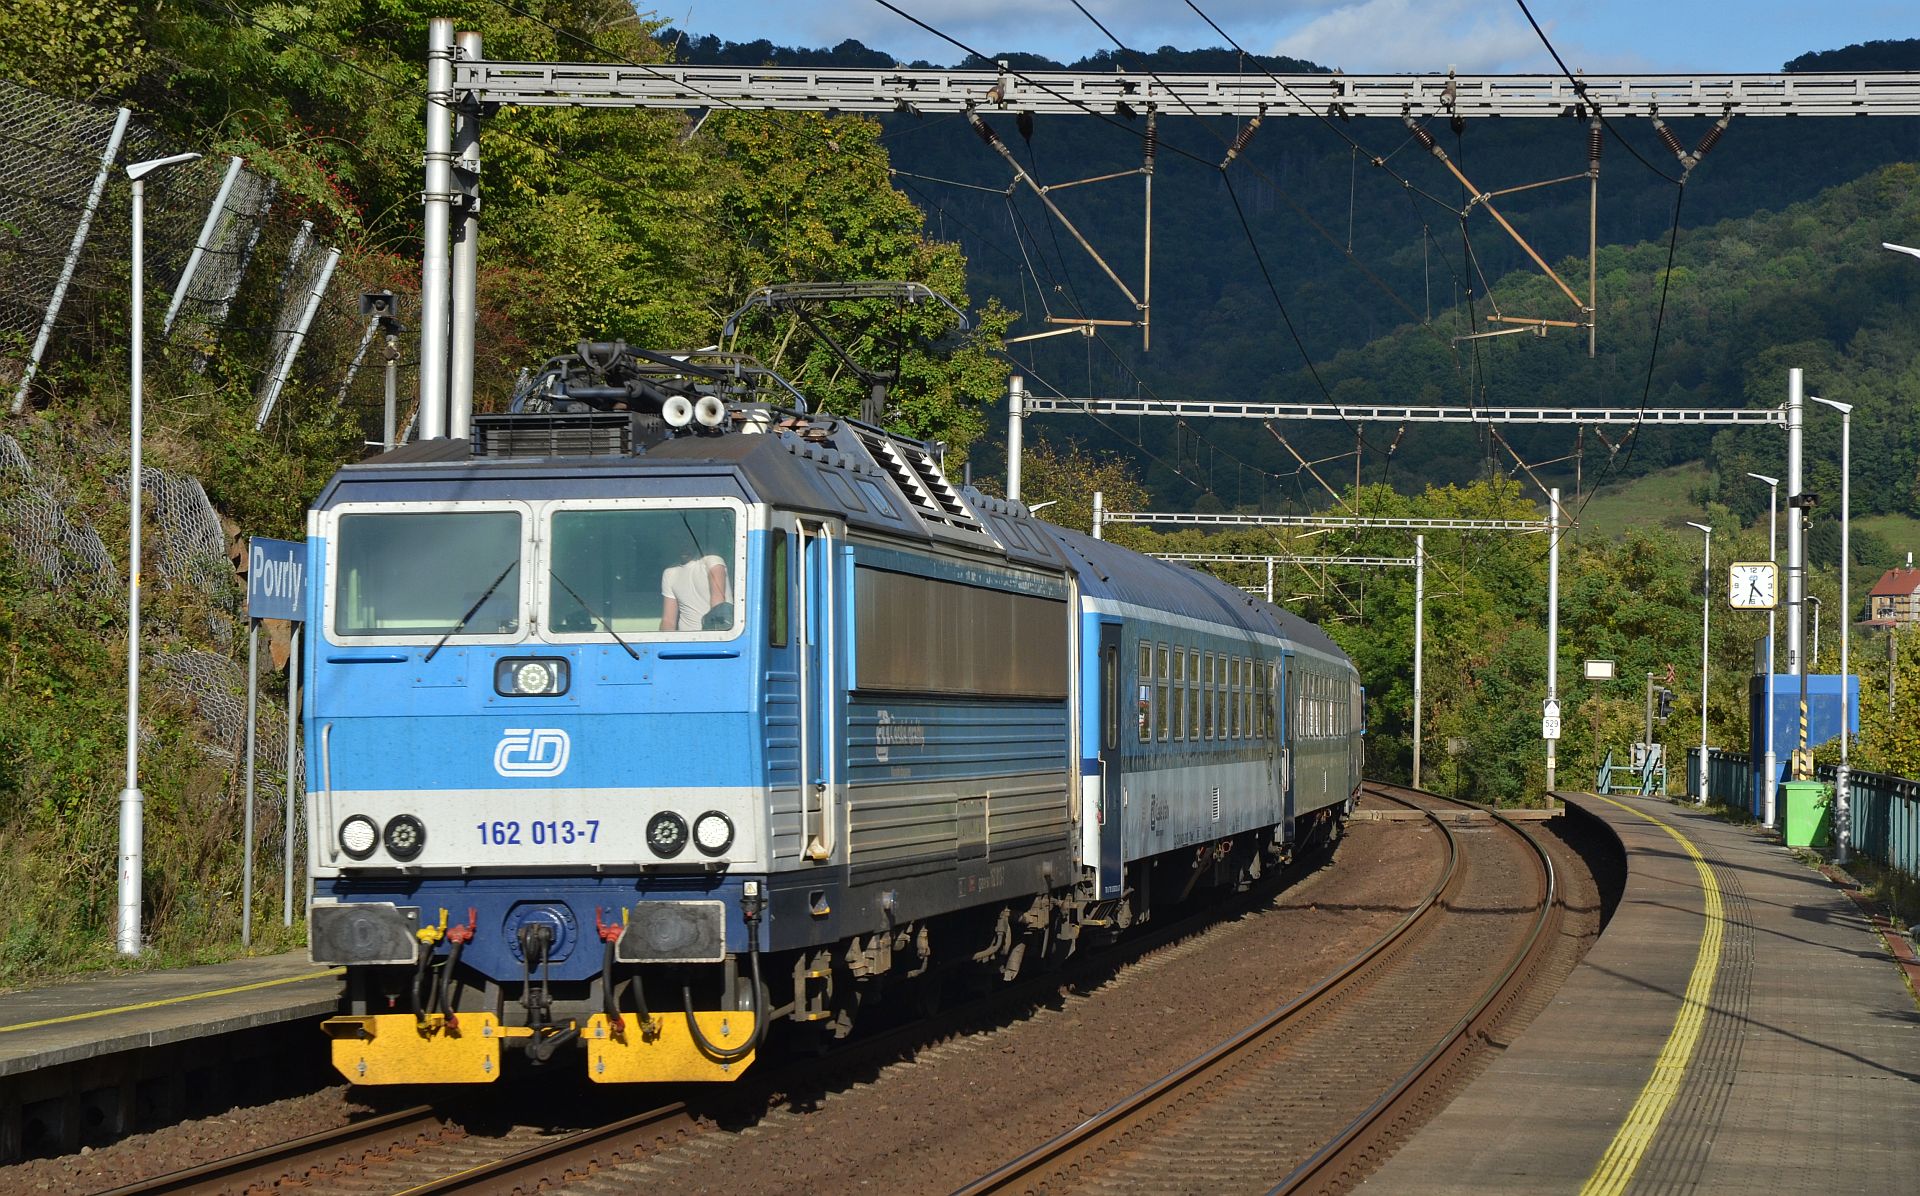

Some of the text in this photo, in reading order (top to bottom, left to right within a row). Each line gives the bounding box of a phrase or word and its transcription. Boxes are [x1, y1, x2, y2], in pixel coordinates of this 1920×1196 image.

[252, 545, 302, 612] Povrly
[477, 820, 600, 845] 162 013-7
